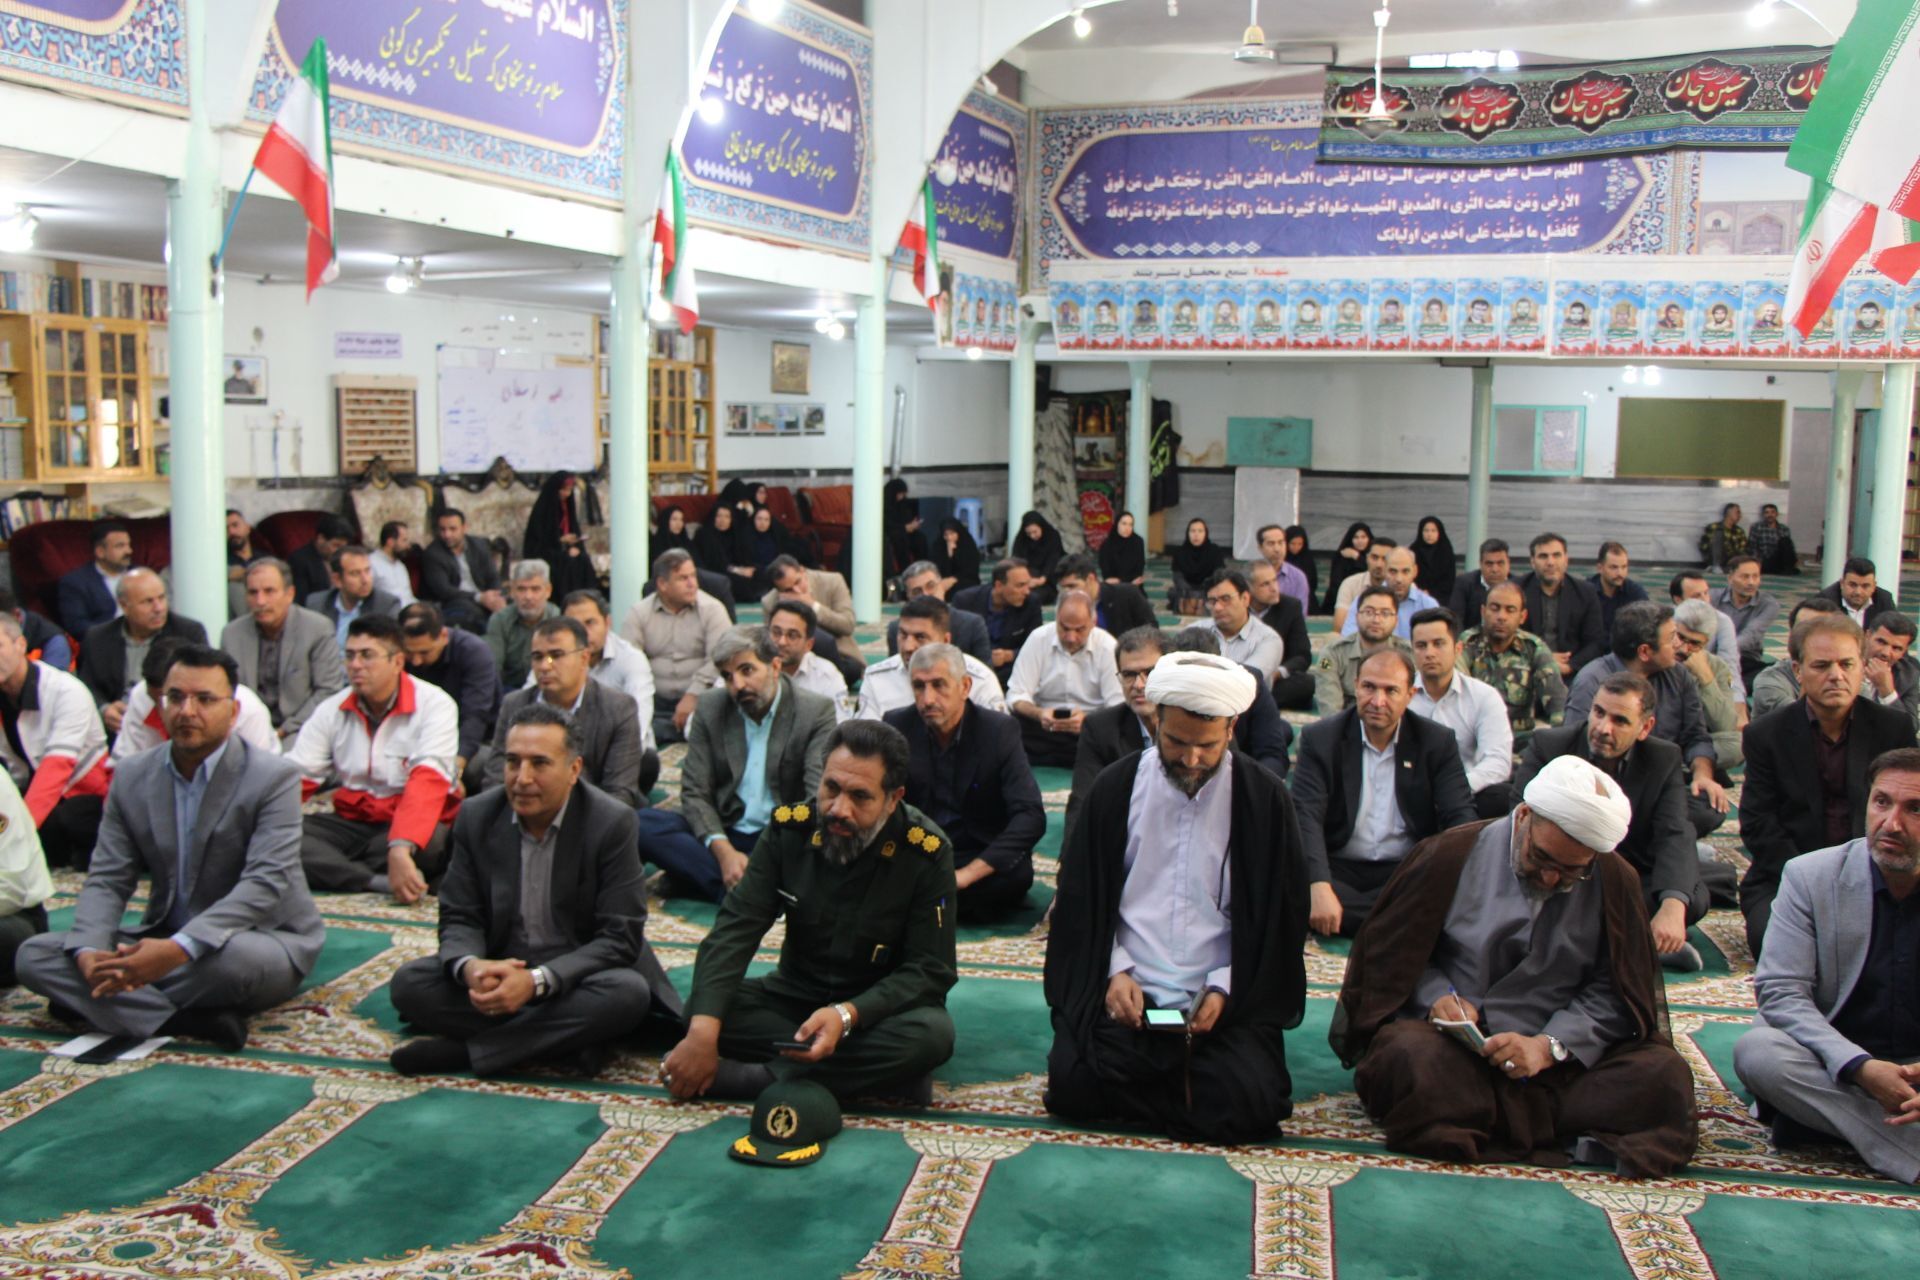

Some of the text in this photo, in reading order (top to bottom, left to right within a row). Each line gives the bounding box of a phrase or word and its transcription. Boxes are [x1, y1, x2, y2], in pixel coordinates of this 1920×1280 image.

[1665, 71, 1704, 107] جان
[1698, 76, 1752, 113] حسین
[1440, 95, 1474, 129] جان
[1550, 87, 1587, 122] جان
[1583, 87, 1634, 125] حسین
[1471, 97, 1520, 133] حسین
[1104, 169, 1125, 194] فوق
[1373, 167, 1412, 186] الرضا
[1414, 167, 1449, 185] موسی
[1450, 169, 1465, 189] بن
[1467, 166, 1493, 184] علی
[1494, 165, 1519, 183] علی
[1554, 162, 1584, 181] اللهم
[1126, 174, 1142, 191] من
[1144, 175, 1166, 192] علی
[1485, 190, 1513, 210] تحت
[1465, 221, 1491, 244] علی
[1526, 222, 1540, 239] ما
